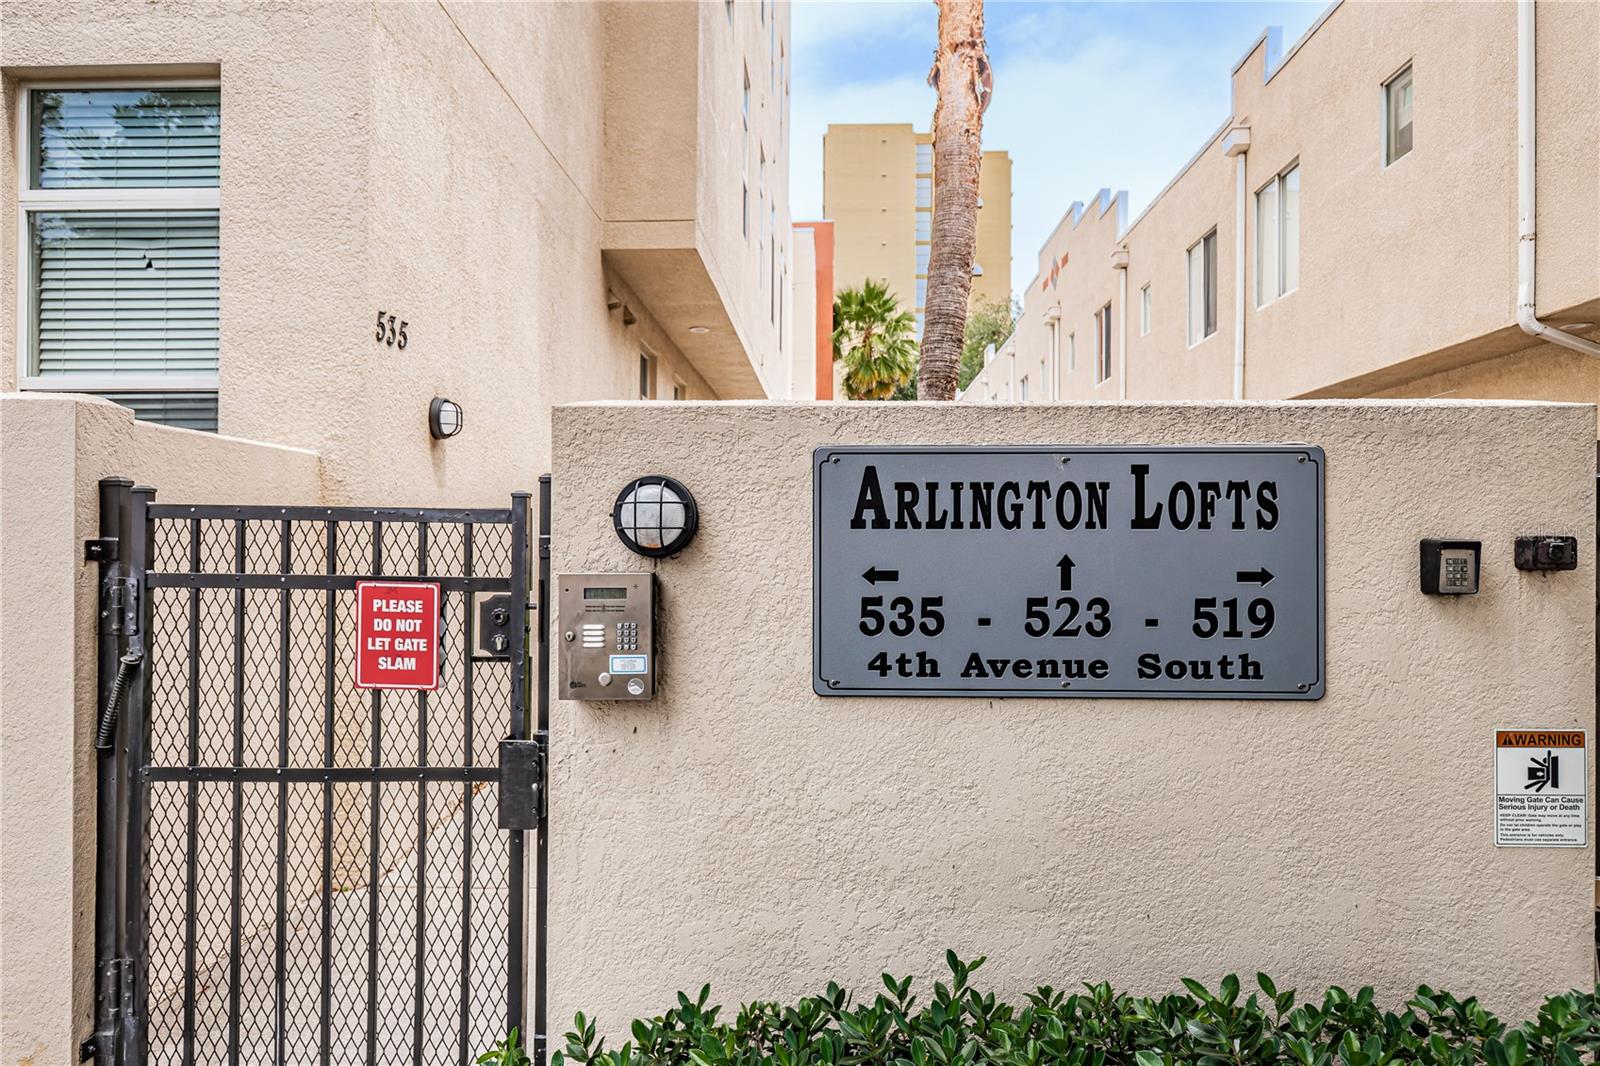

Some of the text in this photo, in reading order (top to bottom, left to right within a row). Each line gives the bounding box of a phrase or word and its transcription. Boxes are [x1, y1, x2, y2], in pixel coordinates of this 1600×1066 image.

[375, 310, 409, 351] 535
[850, 463, 1280, 531] ARLINGTON LOFTS
[372, 598, 424, 613] PLEASE
[373, 618, 422, 632] DO NOT
[858, 596, 945, 637] 535
[1025, 596, 1112, 638] 523
[1192, 596, 1276, 640] 519
[367, 637, 427, 651] LET GATE
[378, 657, 416, 671] SLAM
[867, 650, 1266, 680] 4th Avenue South
[1514, 734, 1582, 746] WARNING
[1527, 804, 1548, 812] Injury
